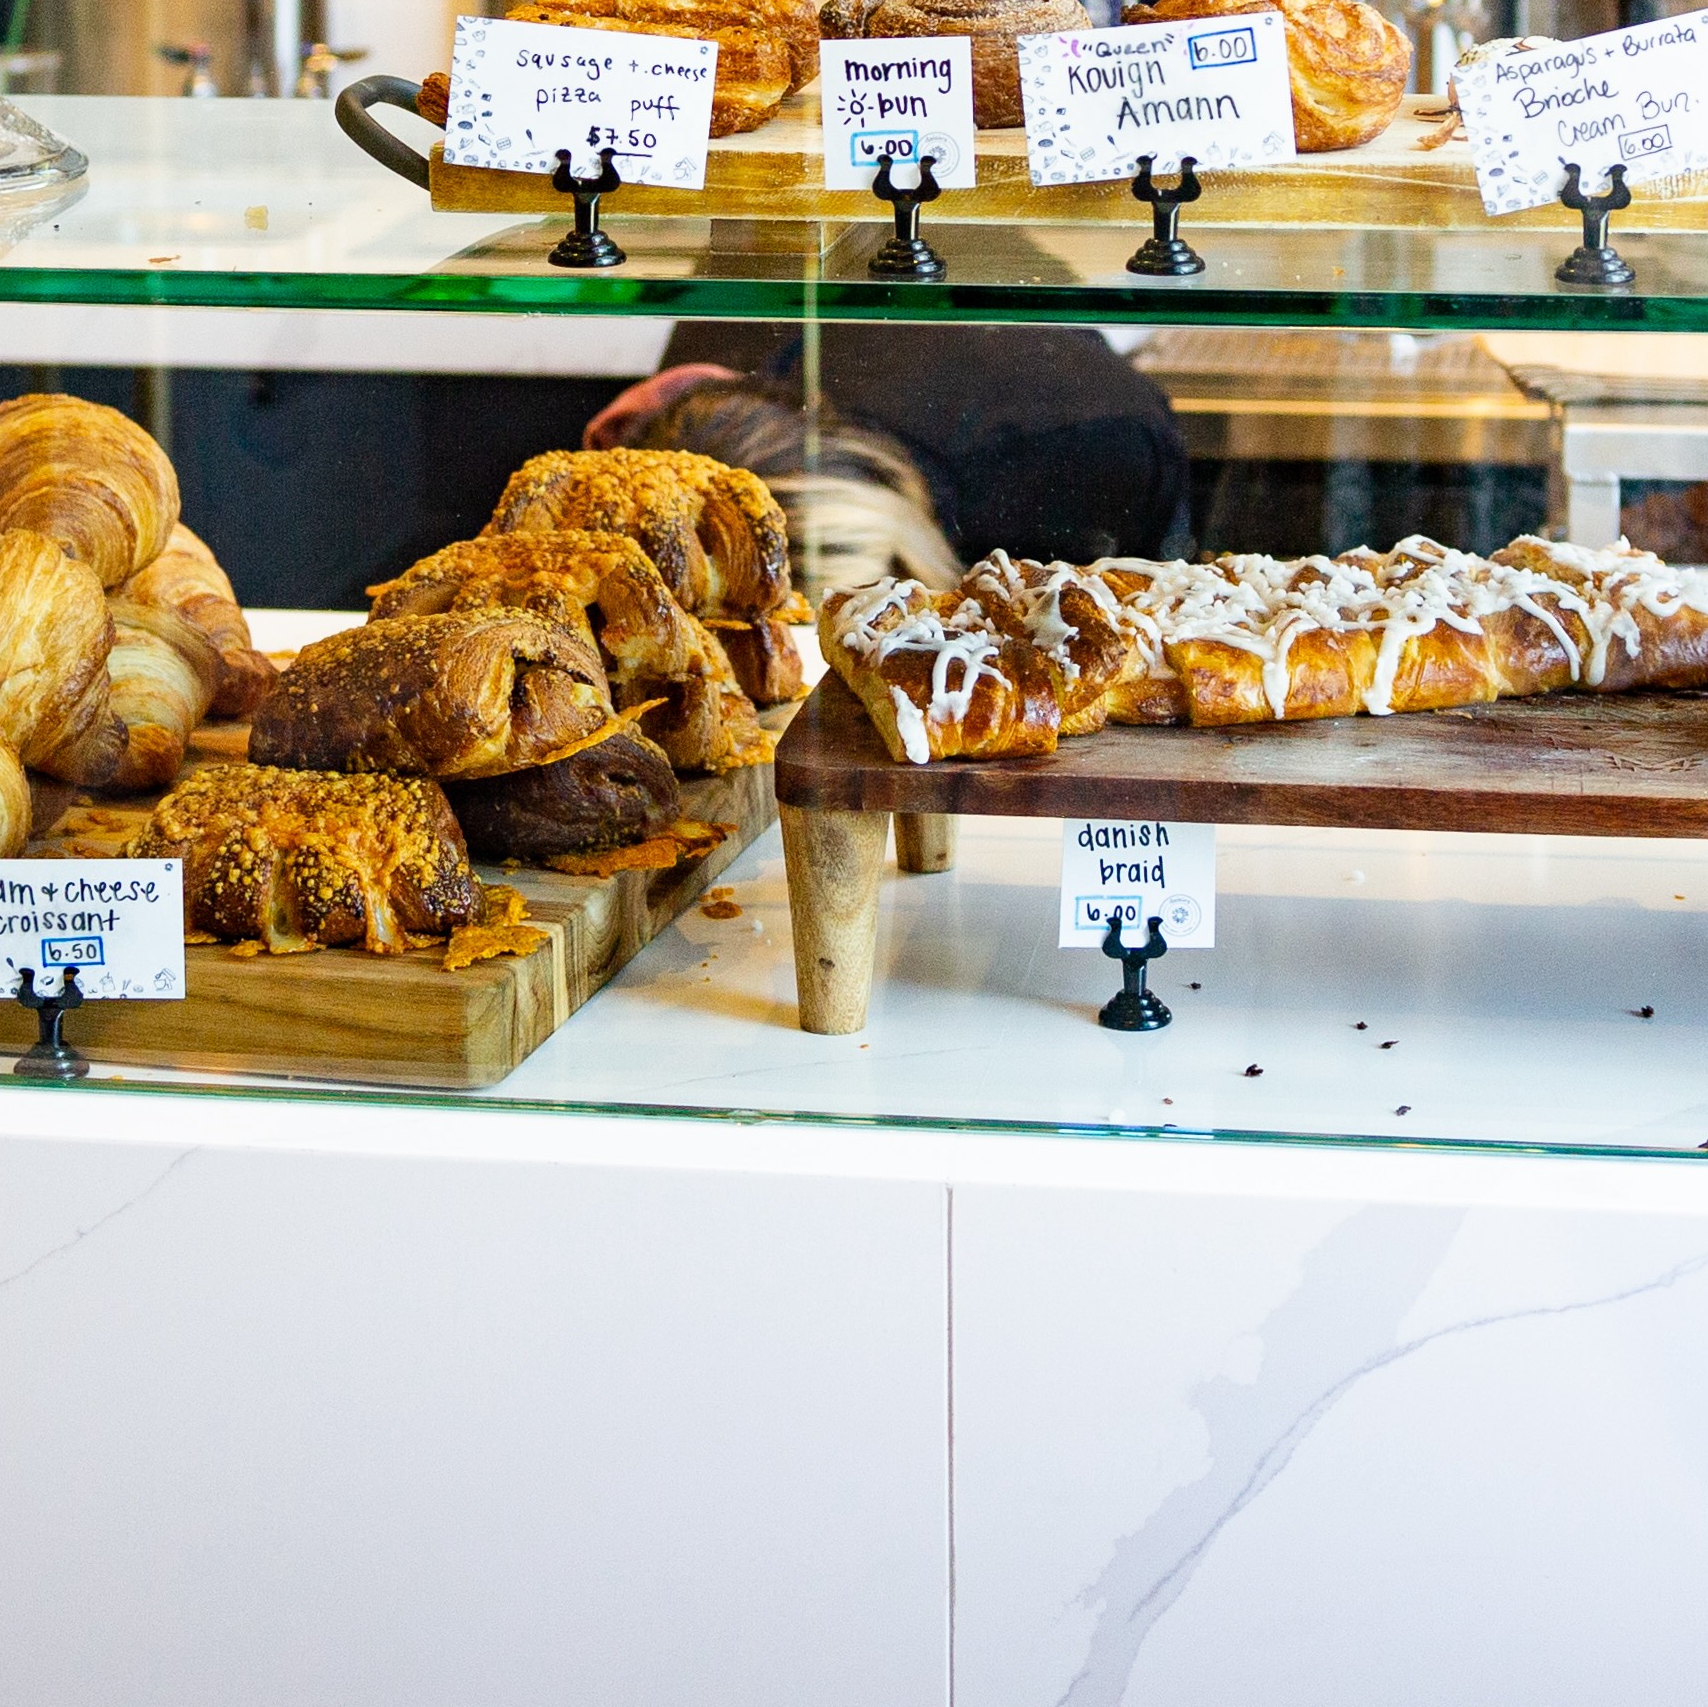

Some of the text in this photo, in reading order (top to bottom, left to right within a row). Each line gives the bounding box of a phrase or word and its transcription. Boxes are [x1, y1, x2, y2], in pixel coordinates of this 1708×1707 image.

[1193, 36, 1248, 62] 6.00
[1495, 24, 1697, 85] Asparagus Burrata
[845, 57, 952, 94] morning
[1068, 60, 1166, 99] Kouign
[536, 87, 680, 121] pizza puff
[877, 92, 928, 119] bun
[1116, 94, 1241, 130] Amann
[1513, 78, 1619, 119] Brioche
[586, 126, 657, 148] $7.50
[861, 139, 913, 157] 6.00
[1624, 132, 1664, 155] 6.00
[1078, 822, 1170, 851] danish
[1099, 855, 1165, 889] braid
[1087, 903, 1136, 921] 6.00
[48, 942, 97, 961] 6.50
